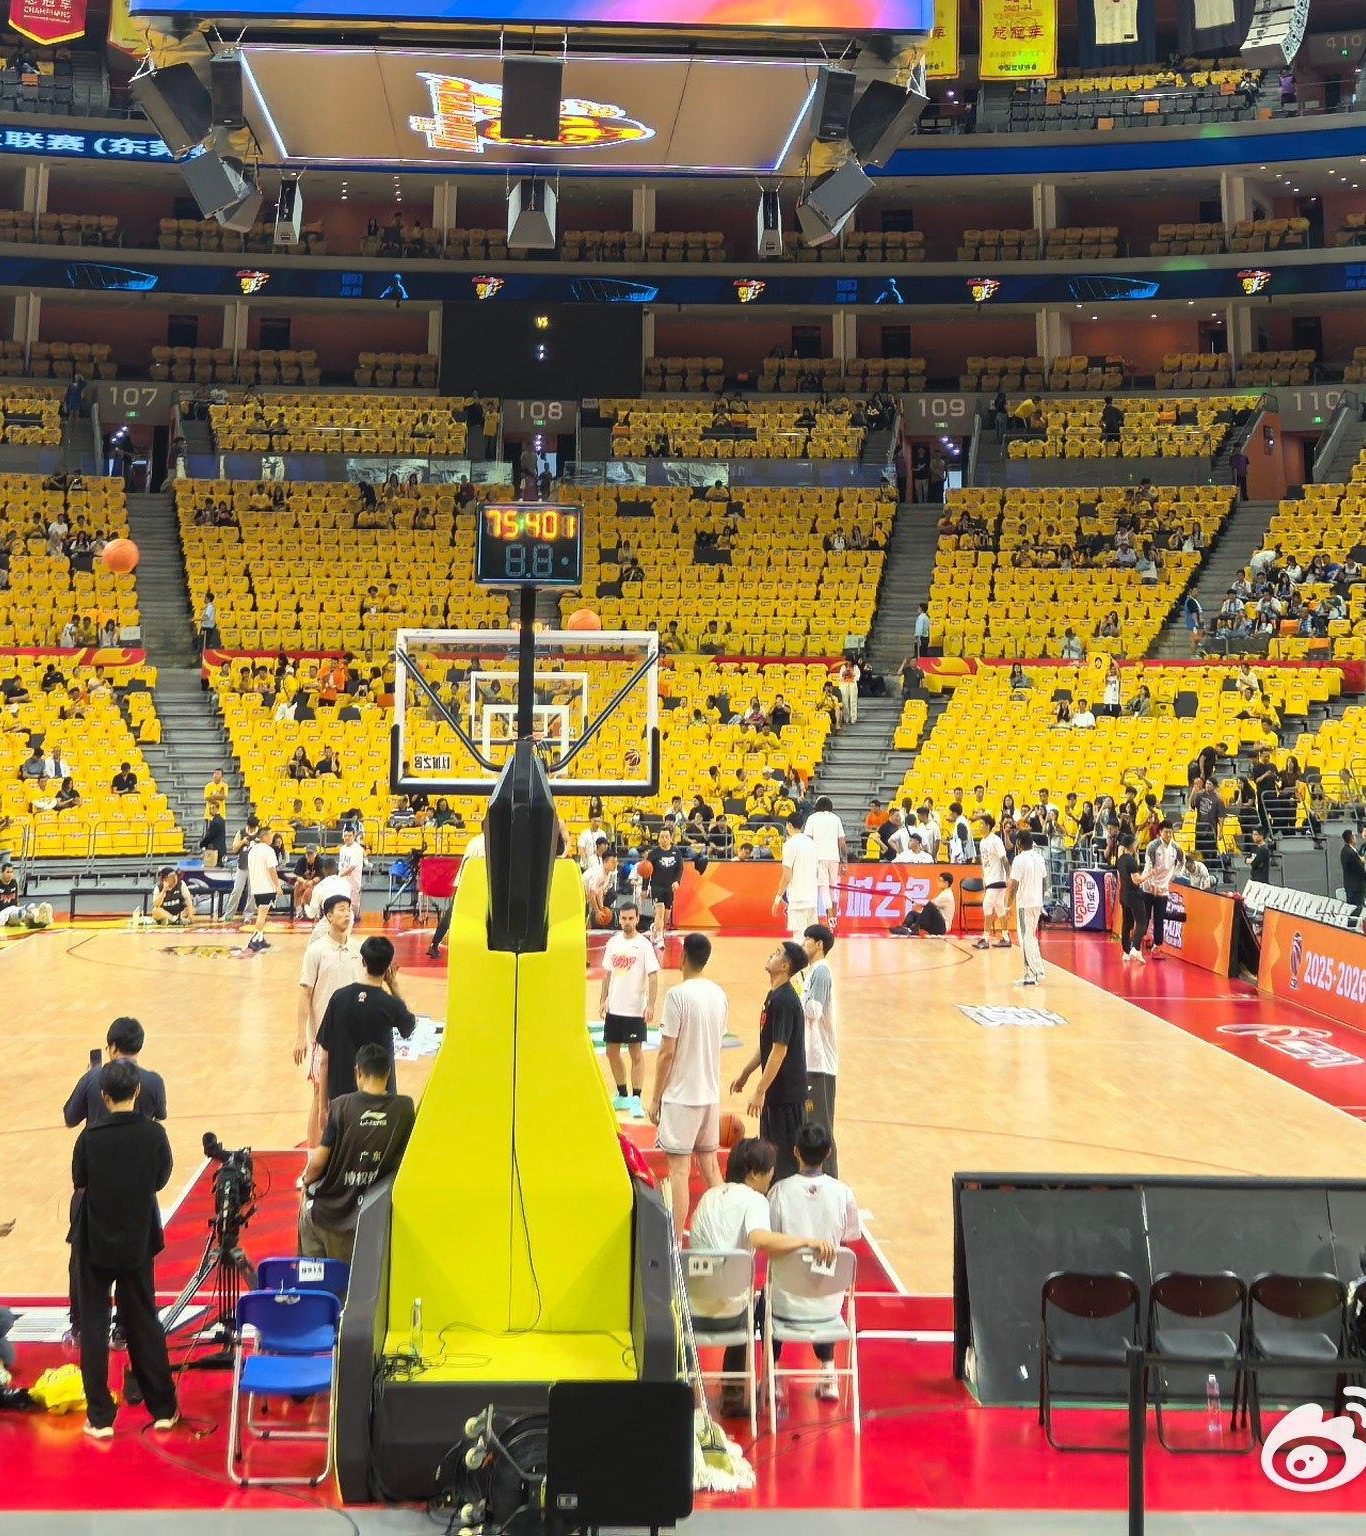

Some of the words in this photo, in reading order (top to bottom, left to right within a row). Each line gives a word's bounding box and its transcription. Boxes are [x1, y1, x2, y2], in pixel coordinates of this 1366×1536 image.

[109, 386, 158, 407] 107
[1293, 391, 1341, 412] 110
[516, 401, 563, 421] 108
[918, 398, 966, 417] 109
